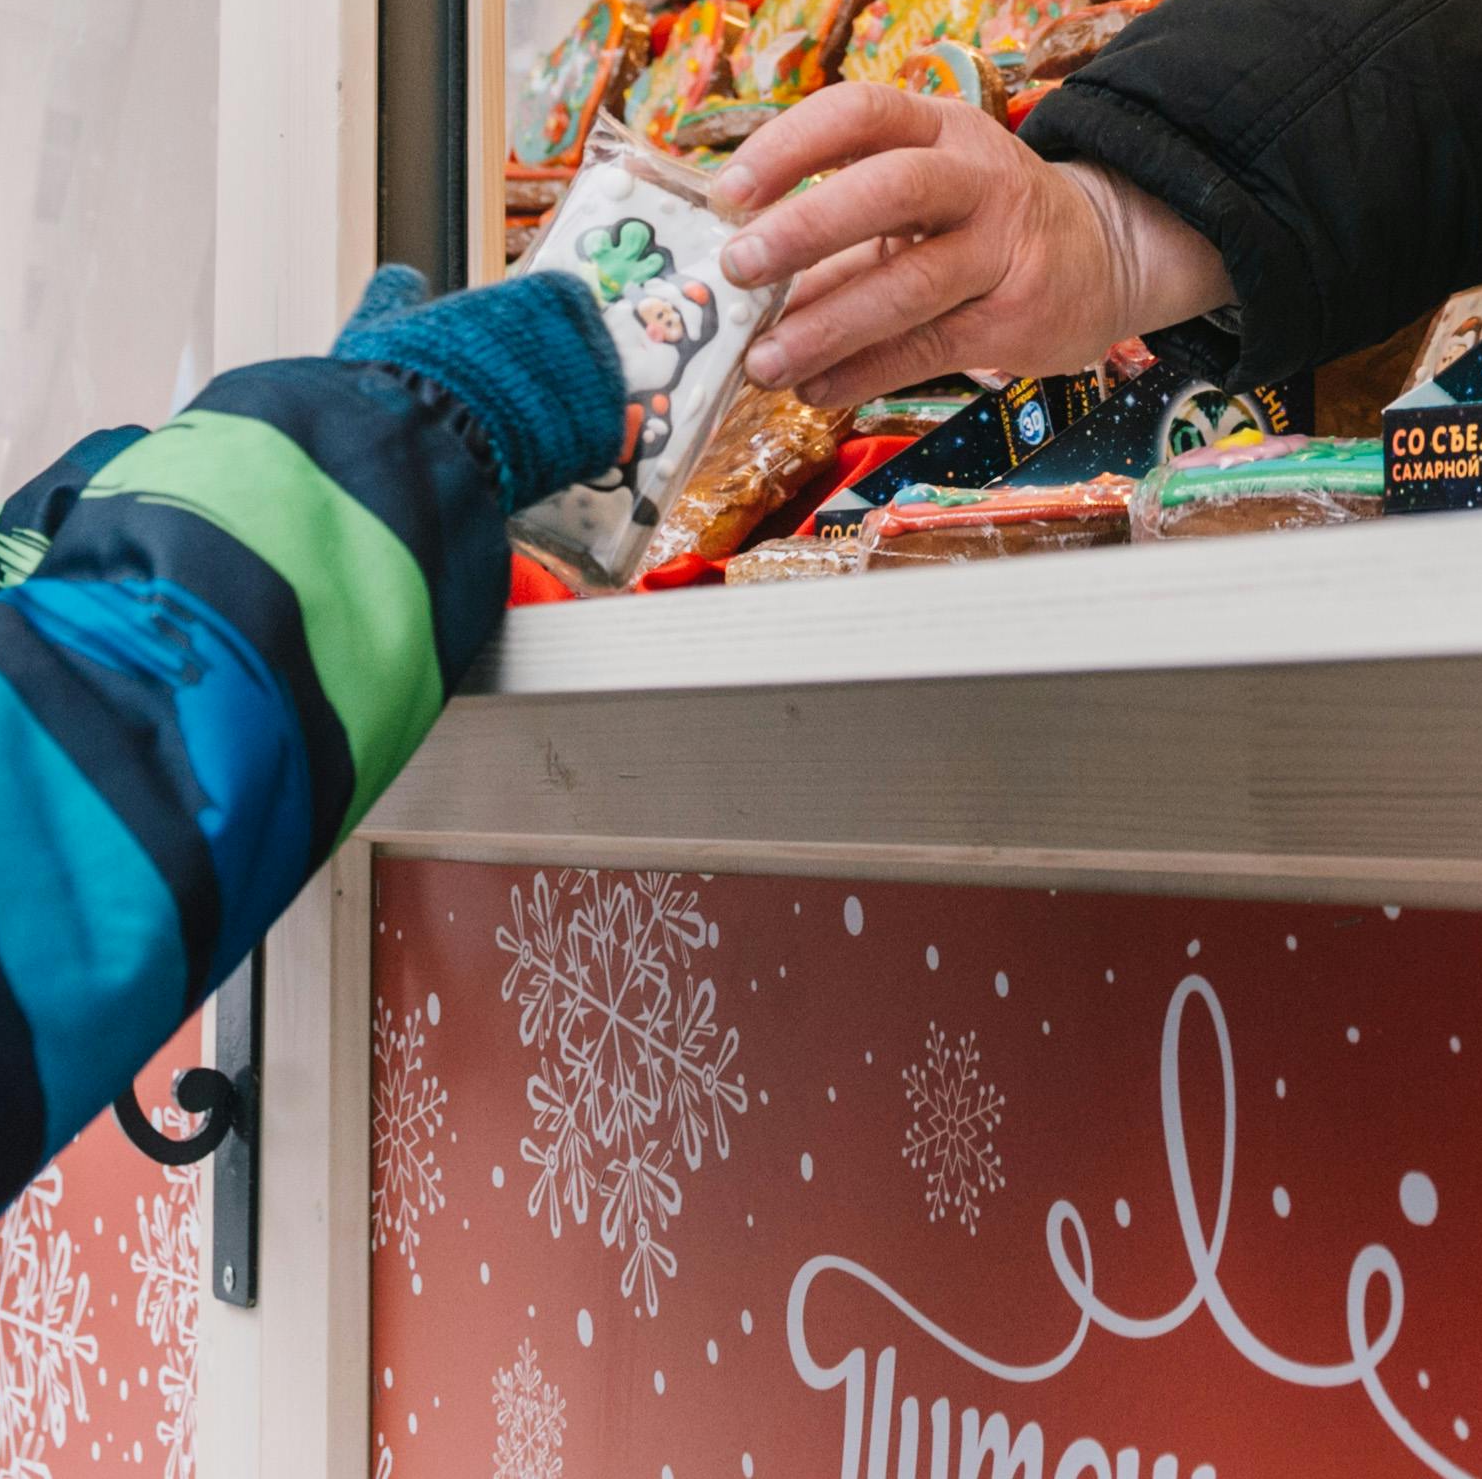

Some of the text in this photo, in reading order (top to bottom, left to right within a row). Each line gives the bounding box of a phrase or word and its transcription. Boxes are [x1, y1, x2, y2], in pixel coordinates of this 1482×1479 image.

[1023, 411, 1041, 437] 3D
[1392, 427, 1425, 457] СО
[1392, 454, 1480, 482] САХАРНОЙ
